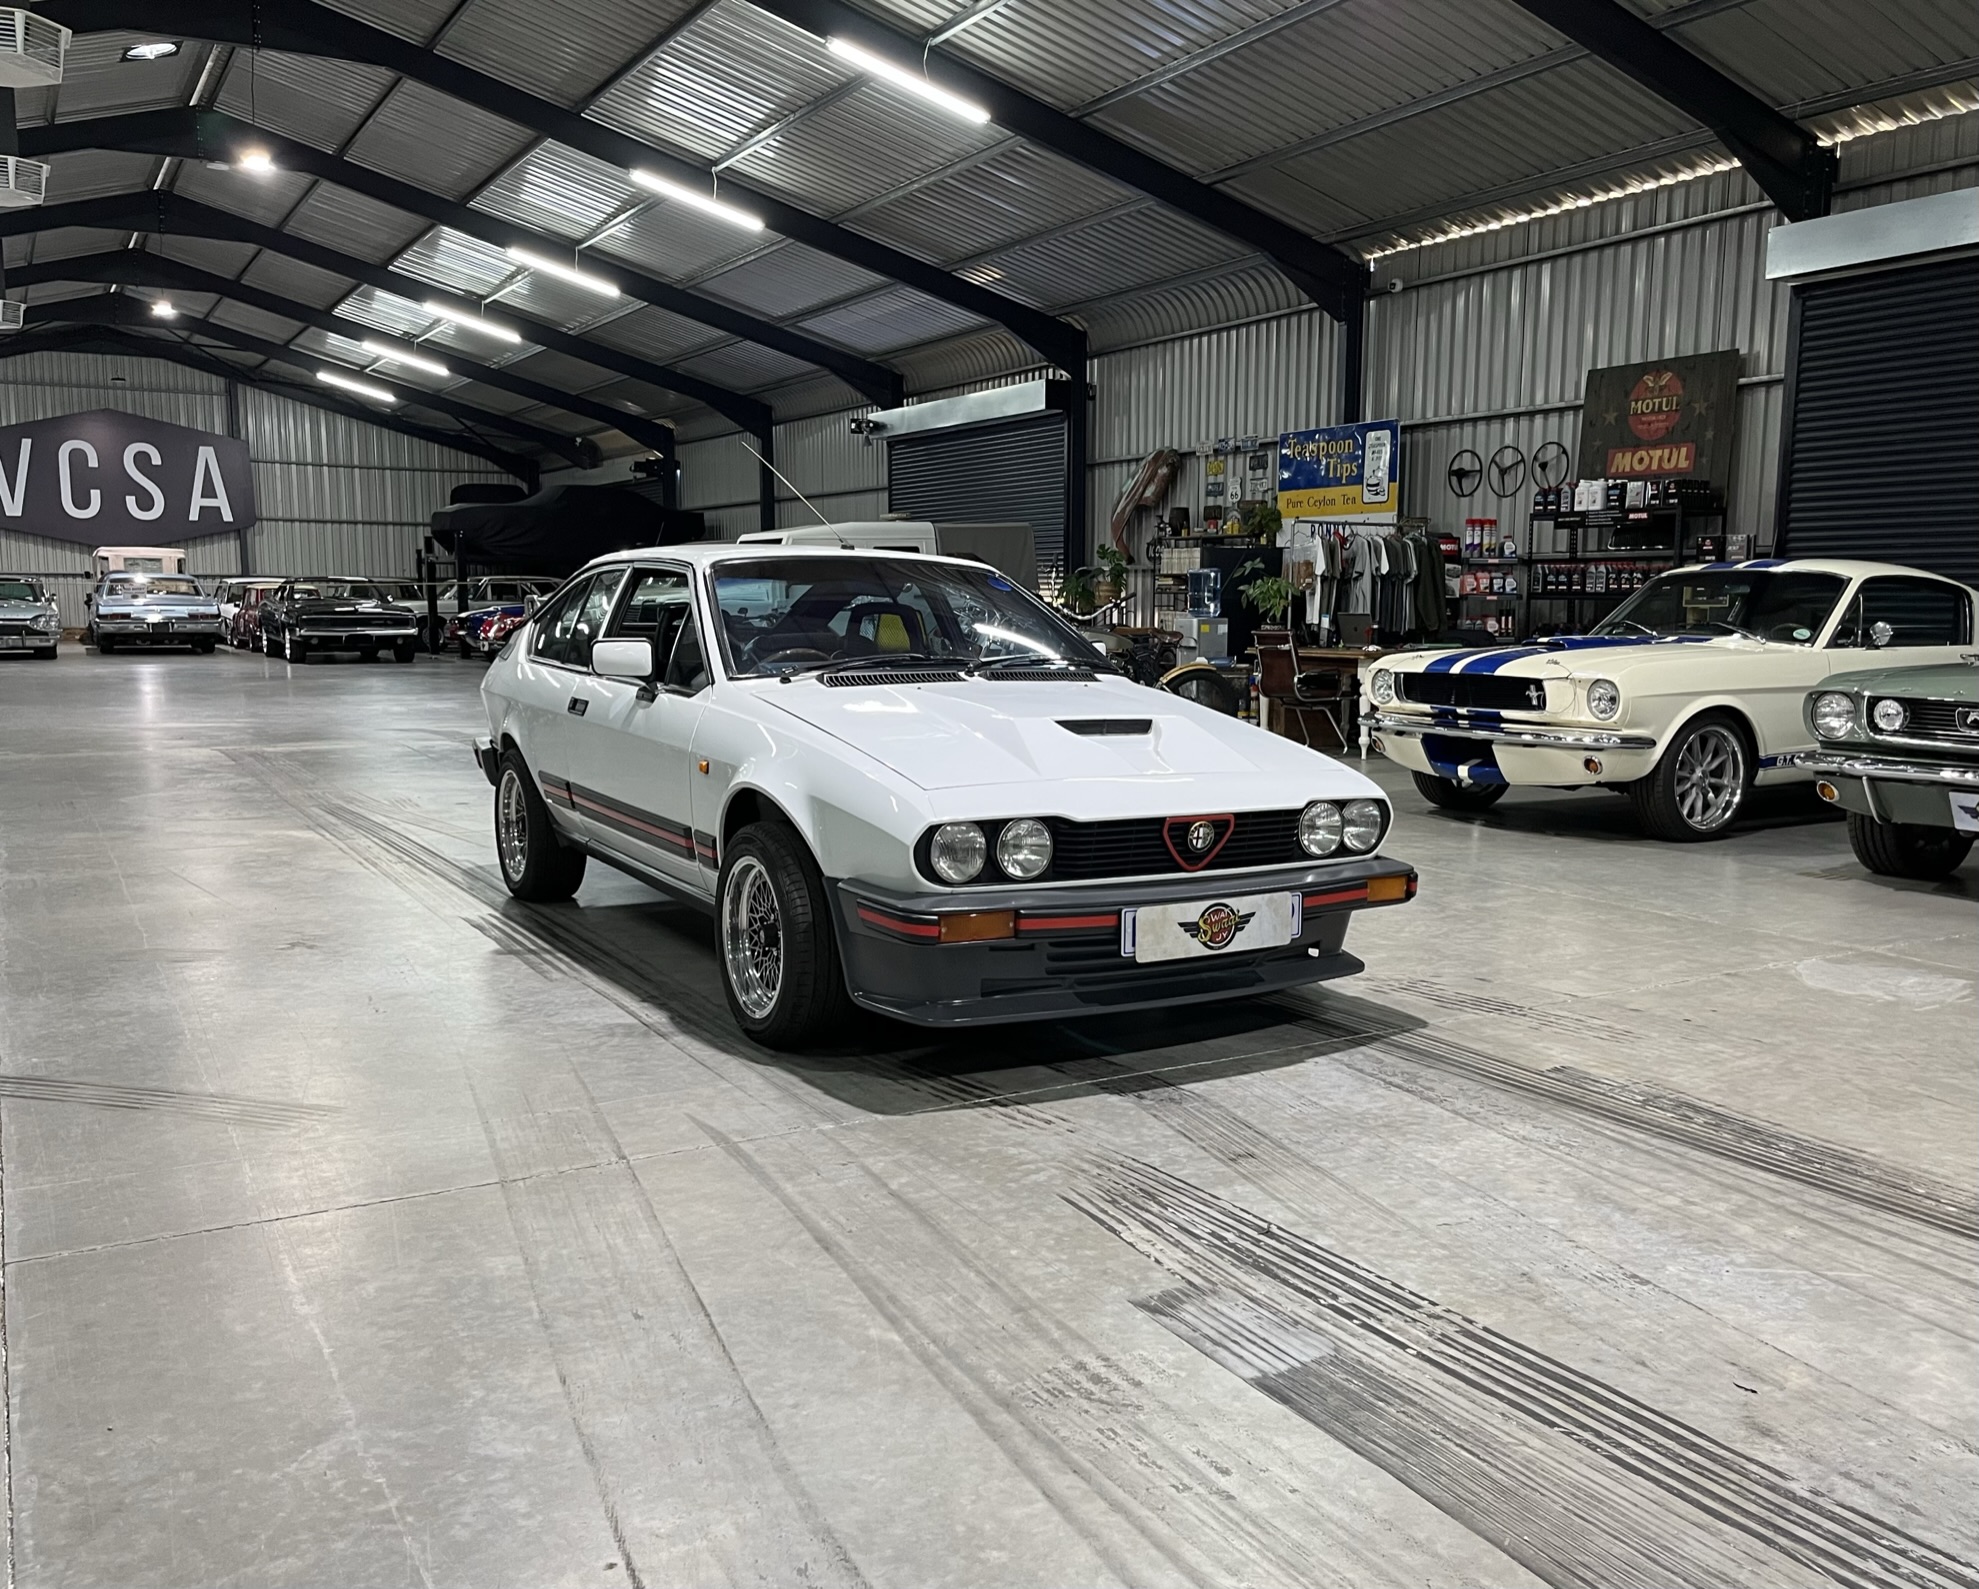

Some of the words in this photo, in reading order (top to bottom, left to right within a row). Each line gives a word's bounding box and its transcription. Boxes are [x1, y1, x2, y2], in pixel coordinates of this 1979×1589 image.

[1630, 396, 1680, 415] MOTUL
[1288, 439, 1354, 460] Teaspoon
[1610, 447, 1690, 474] MOTUL
[0, 438, 234, 523] VCSA
[1327, 458, 1358, 484] Tips
[1230, 491, 1239, 500] 66
[1286, 498, 1304, 510] Pure
[1307, 495, 1336, 510] Ceylon
[1341, 494, 1357, 506] Tea
[1216, 930, 1229, 941] JY
